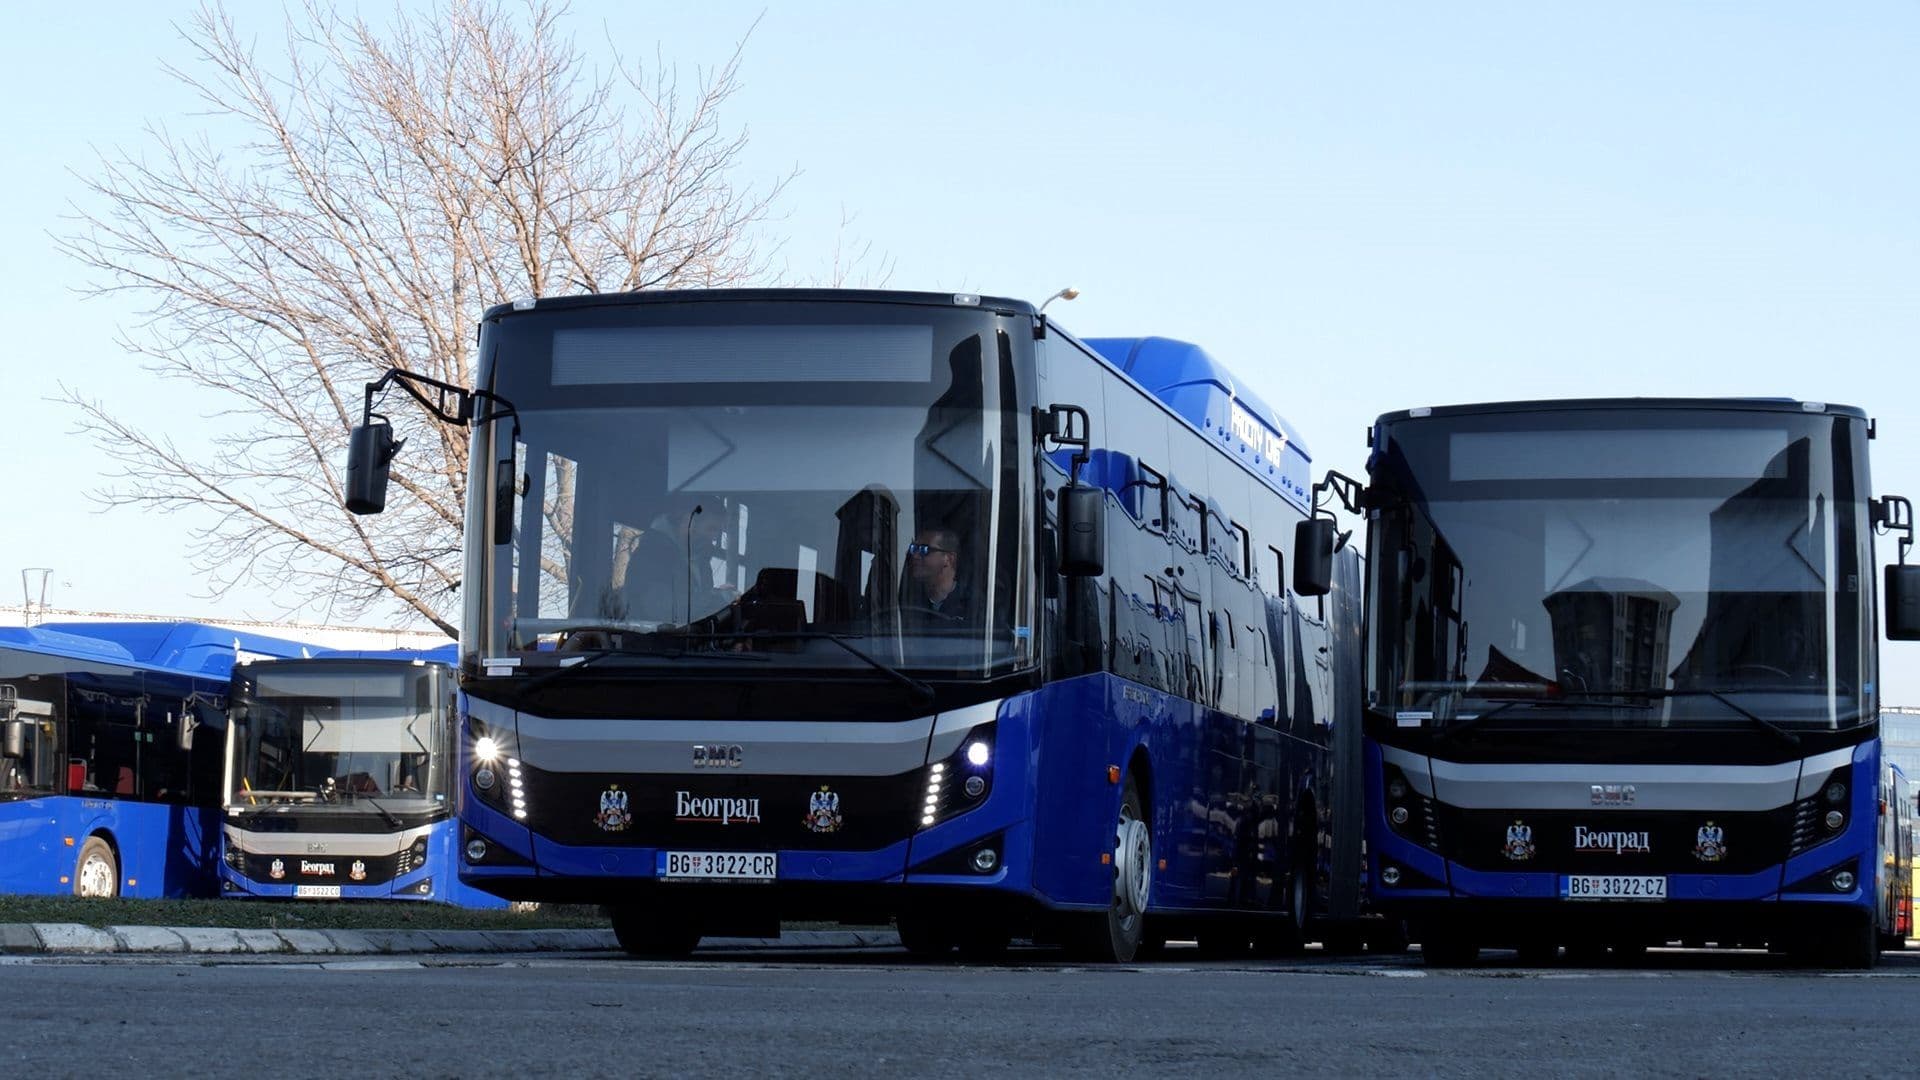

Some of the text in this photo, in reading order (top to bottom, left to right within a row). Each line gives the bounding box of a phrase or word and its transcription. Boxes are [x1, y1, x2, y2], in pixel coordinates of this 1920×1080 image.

[692, 745, 743, 768] BMC
[1591, 784, 1636, 806] BMC
[675, 790, 761, 825] Београд
[1574, 826, 1650, 854] Београд
[301, 860, 335, 875] Београд
[669, 854, 690, 873] BG
[1571, 878, 1590, 894] BG
